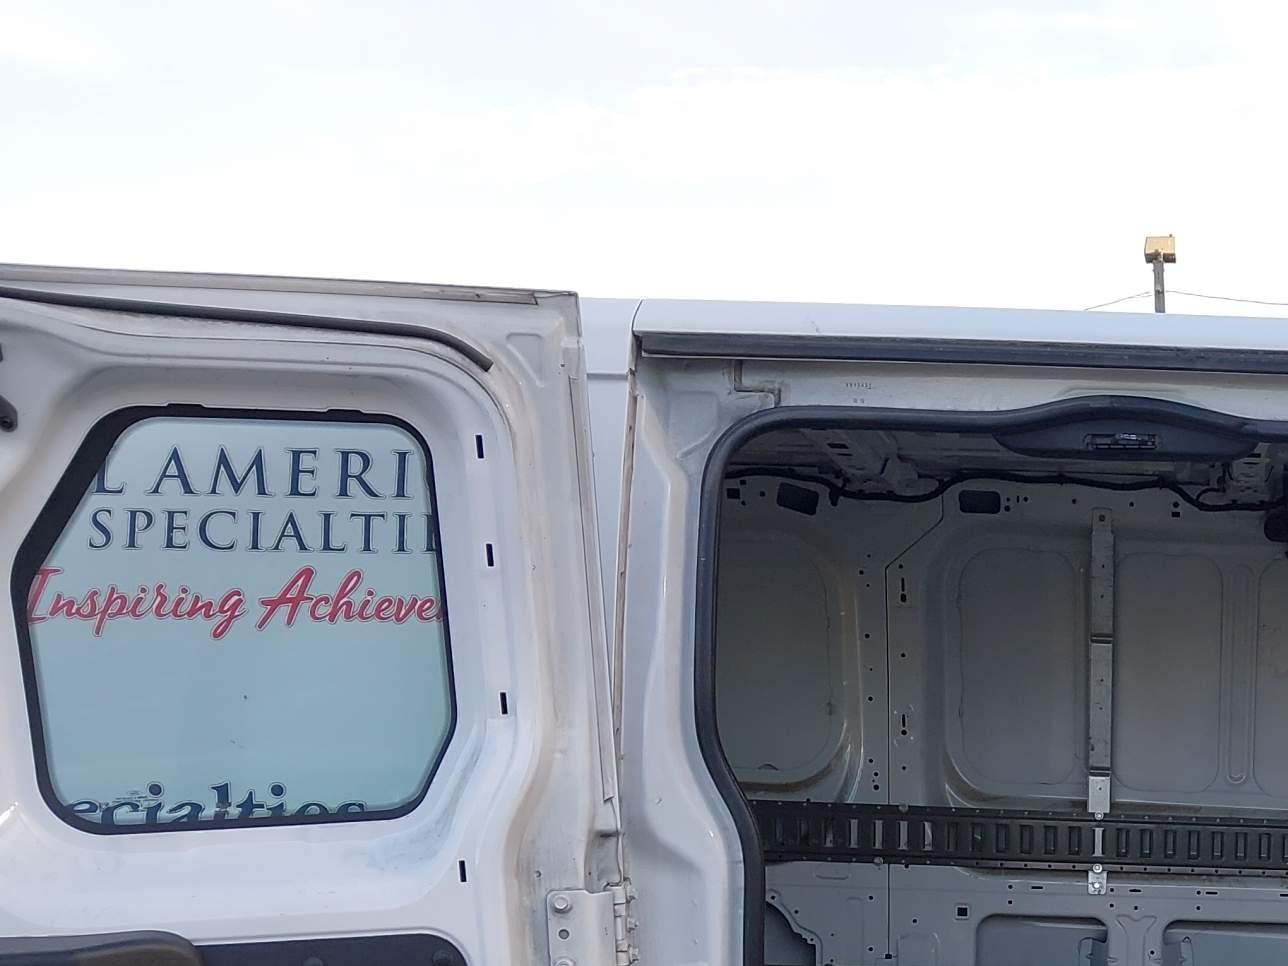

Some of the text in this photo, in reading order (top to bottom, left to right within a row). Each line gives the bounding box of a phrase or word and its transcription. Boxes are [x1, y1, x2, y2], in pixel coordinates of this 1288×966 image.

[148, 446, 414, 499] AMERI
[25, 564, 441, 640] Inspiring Achieve
